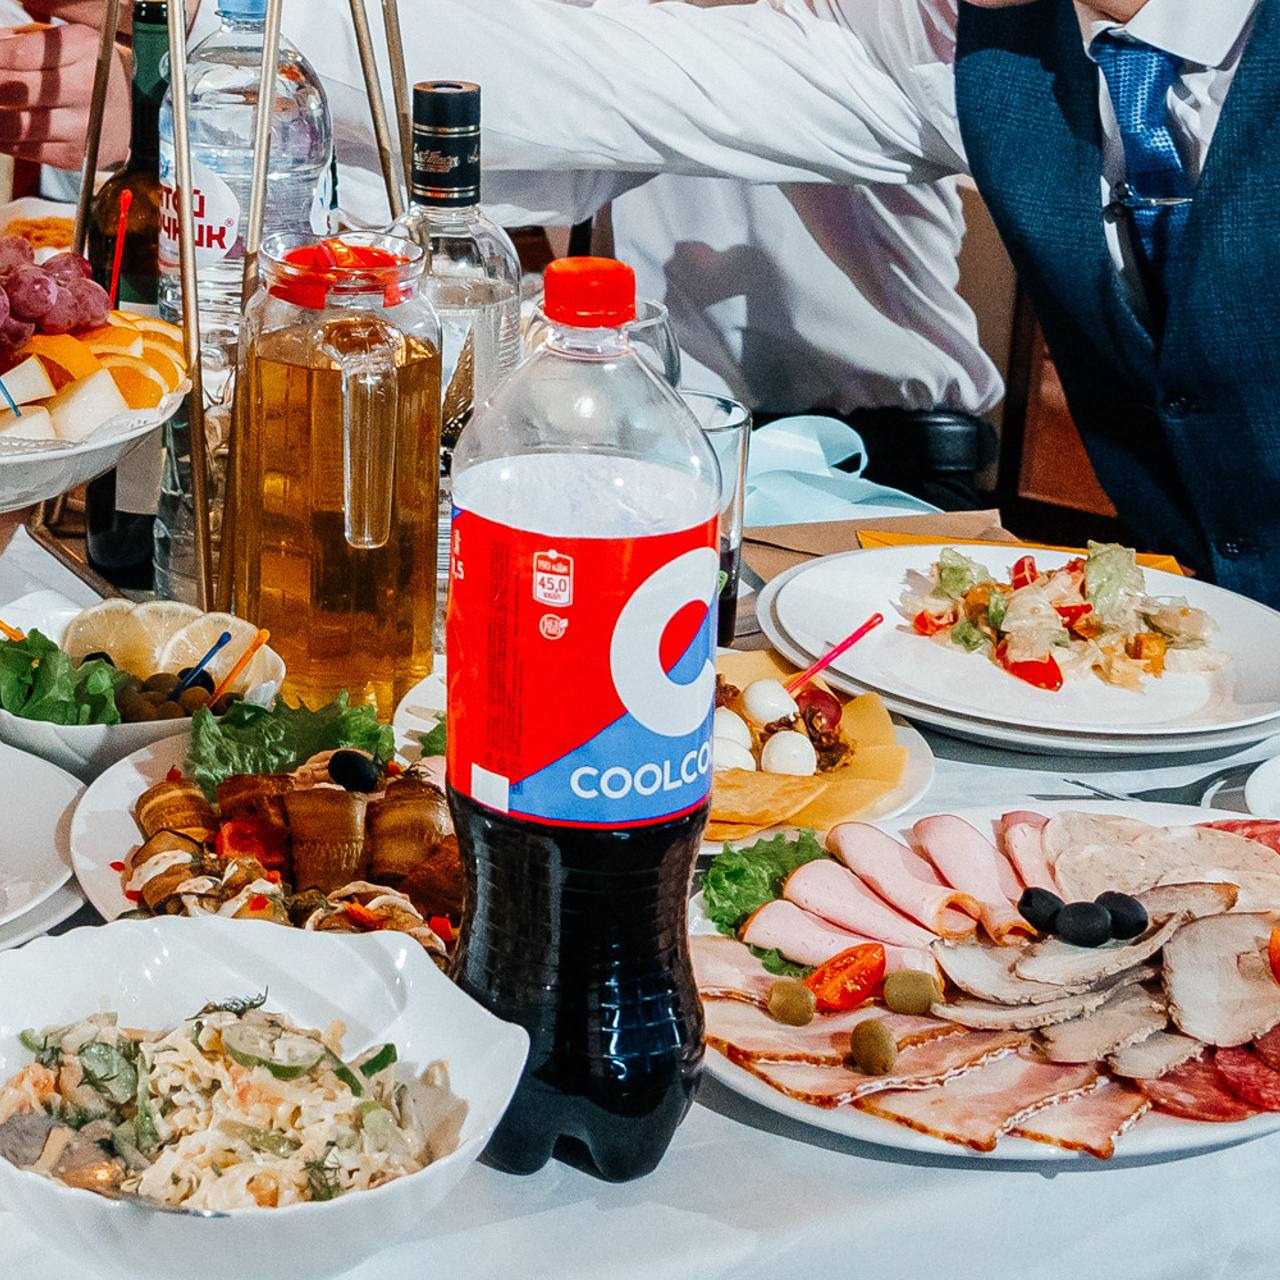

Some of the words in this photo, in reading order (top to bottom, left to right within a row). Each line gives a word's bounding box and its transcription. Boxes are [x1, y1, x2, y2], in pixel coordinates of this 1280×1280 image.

[158, 185, 204, 218] ТОЙ
[159, 213, 227, 250] ЧНИК
[538, 576, 567, 593] 45,0
[570, 740, 711, 800] COOLCO
